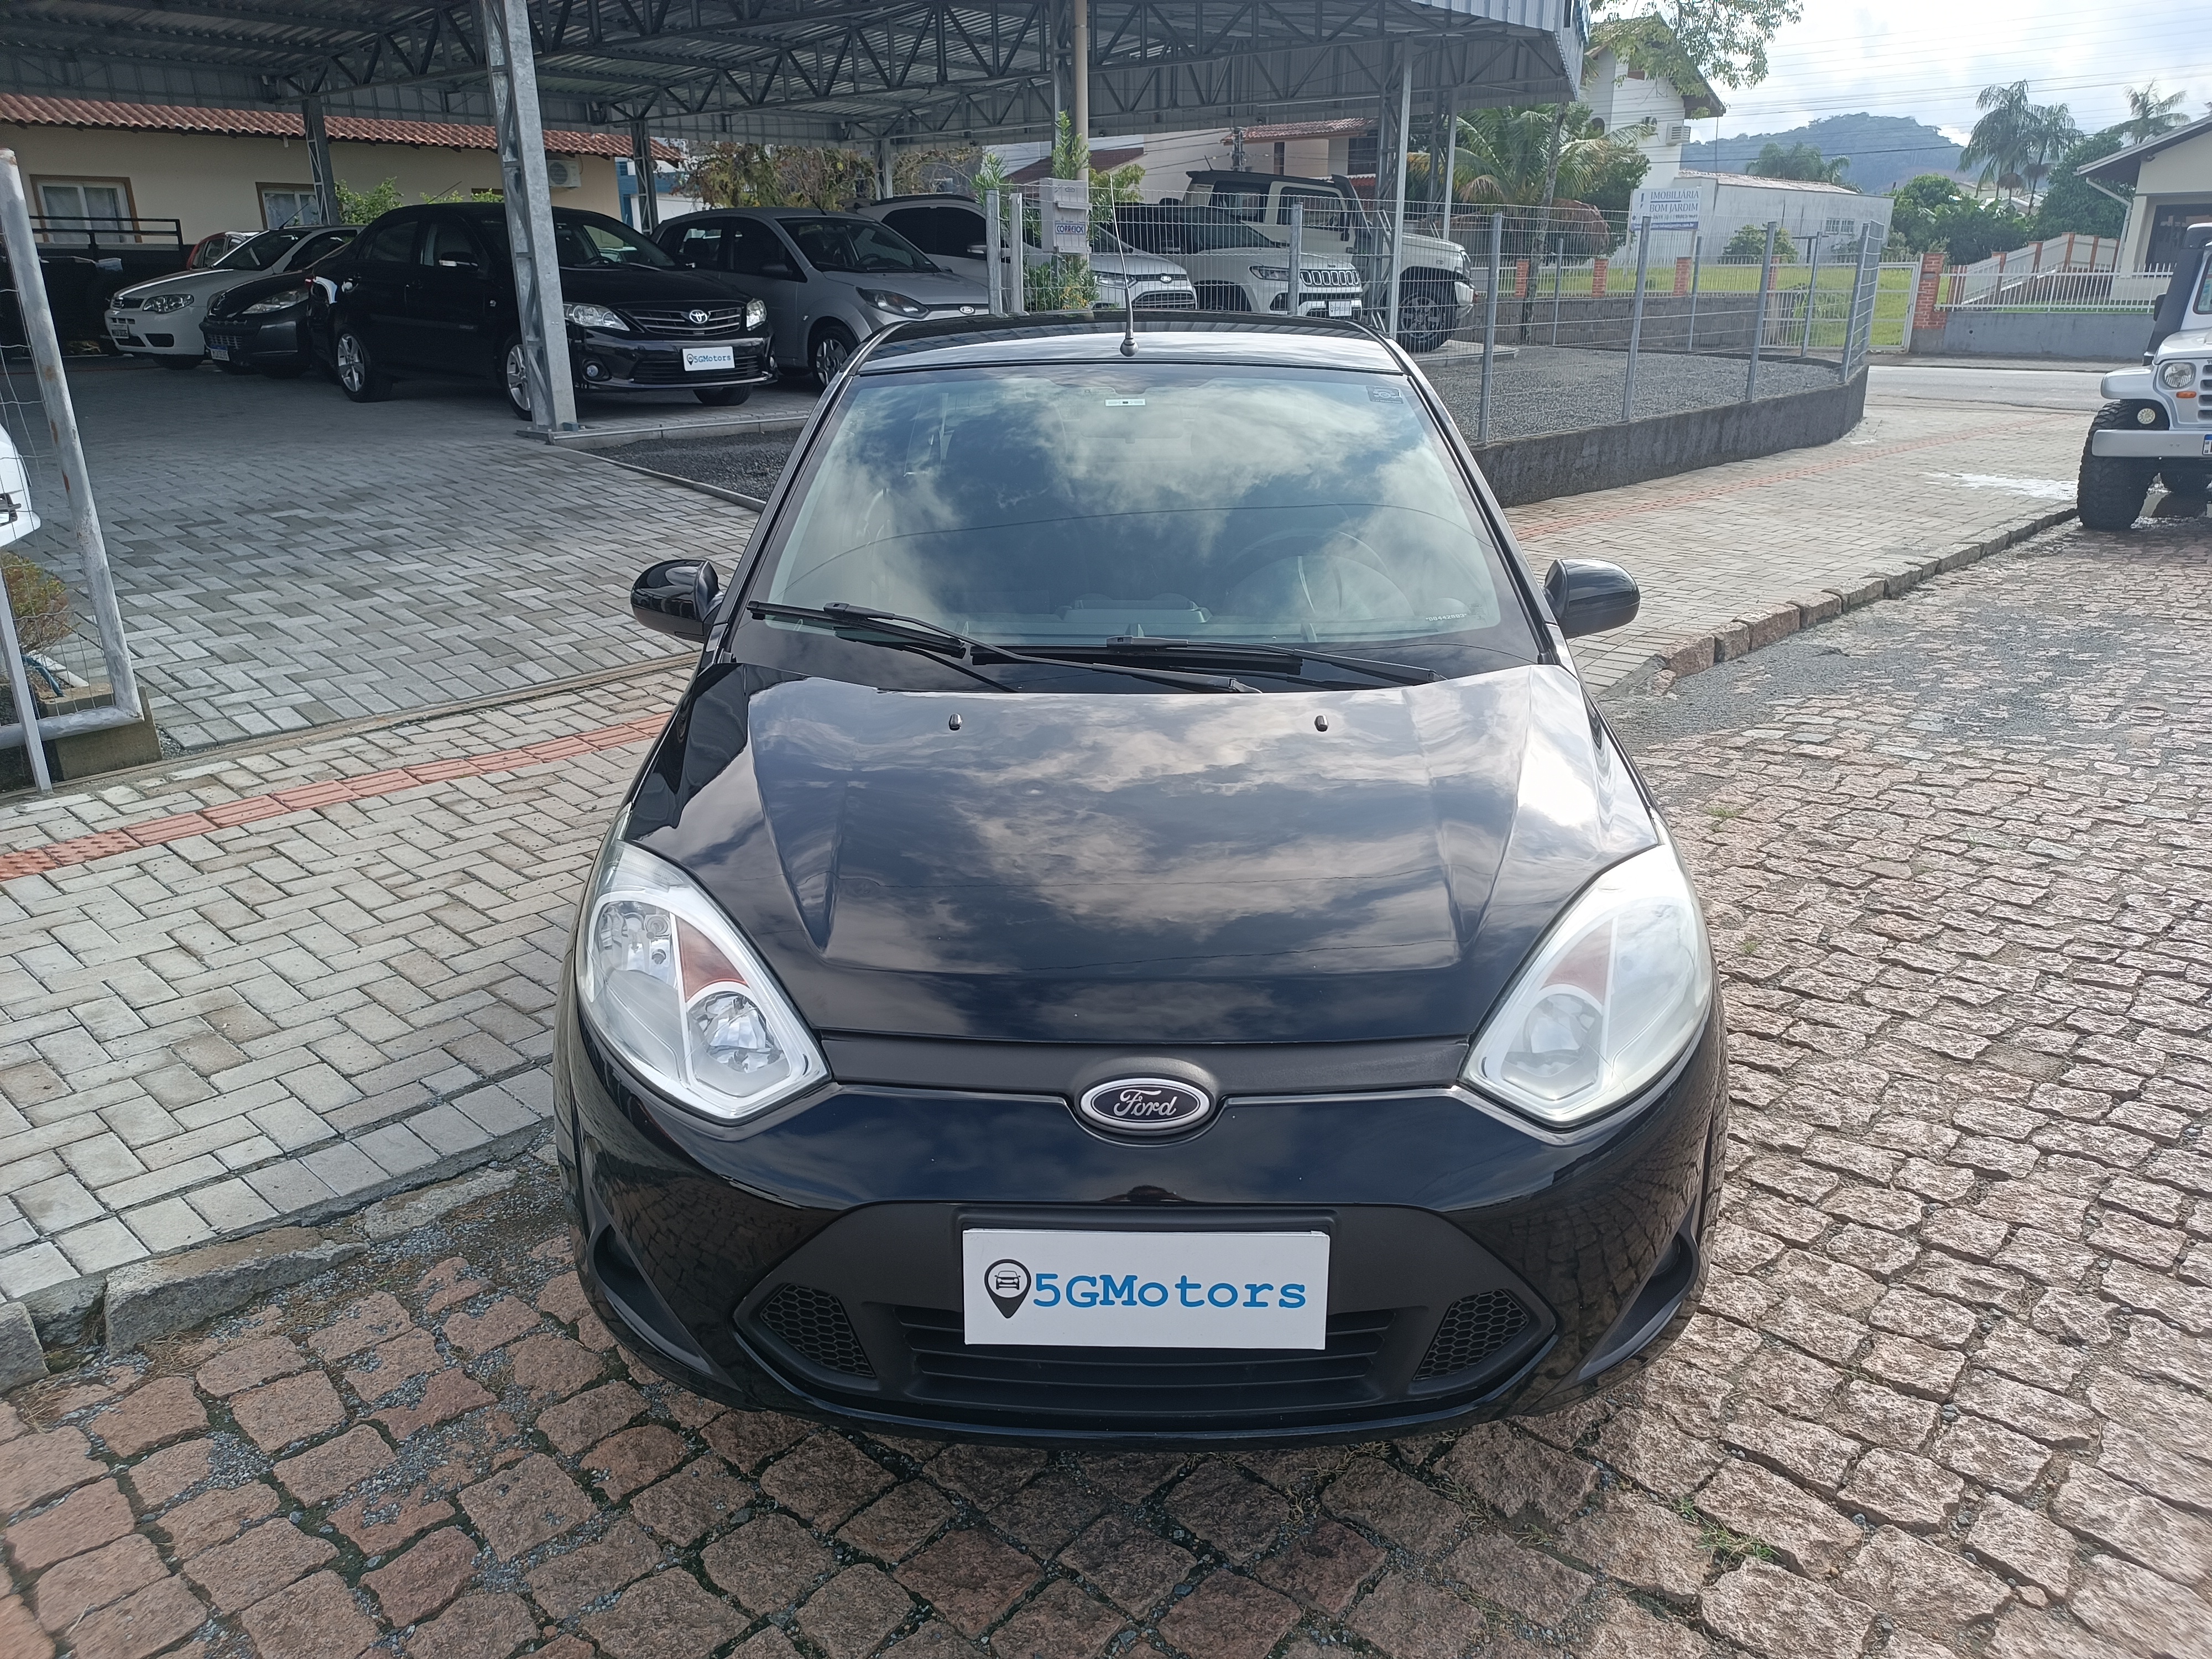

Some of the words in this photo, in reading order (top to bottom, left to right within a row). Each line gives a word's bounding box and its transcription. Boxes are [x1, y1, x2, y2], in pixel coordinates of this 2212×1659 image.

[1651, 189, 1699, 200] IMOBILIÁRIA
[1650, 204, 1667, 212] BOM
[1669, 202, 1698, 213] JARDIM
[1113, 1089, 1178, 1116] Ford
[1033, 1273, 1306, 1308] 5GMotors
